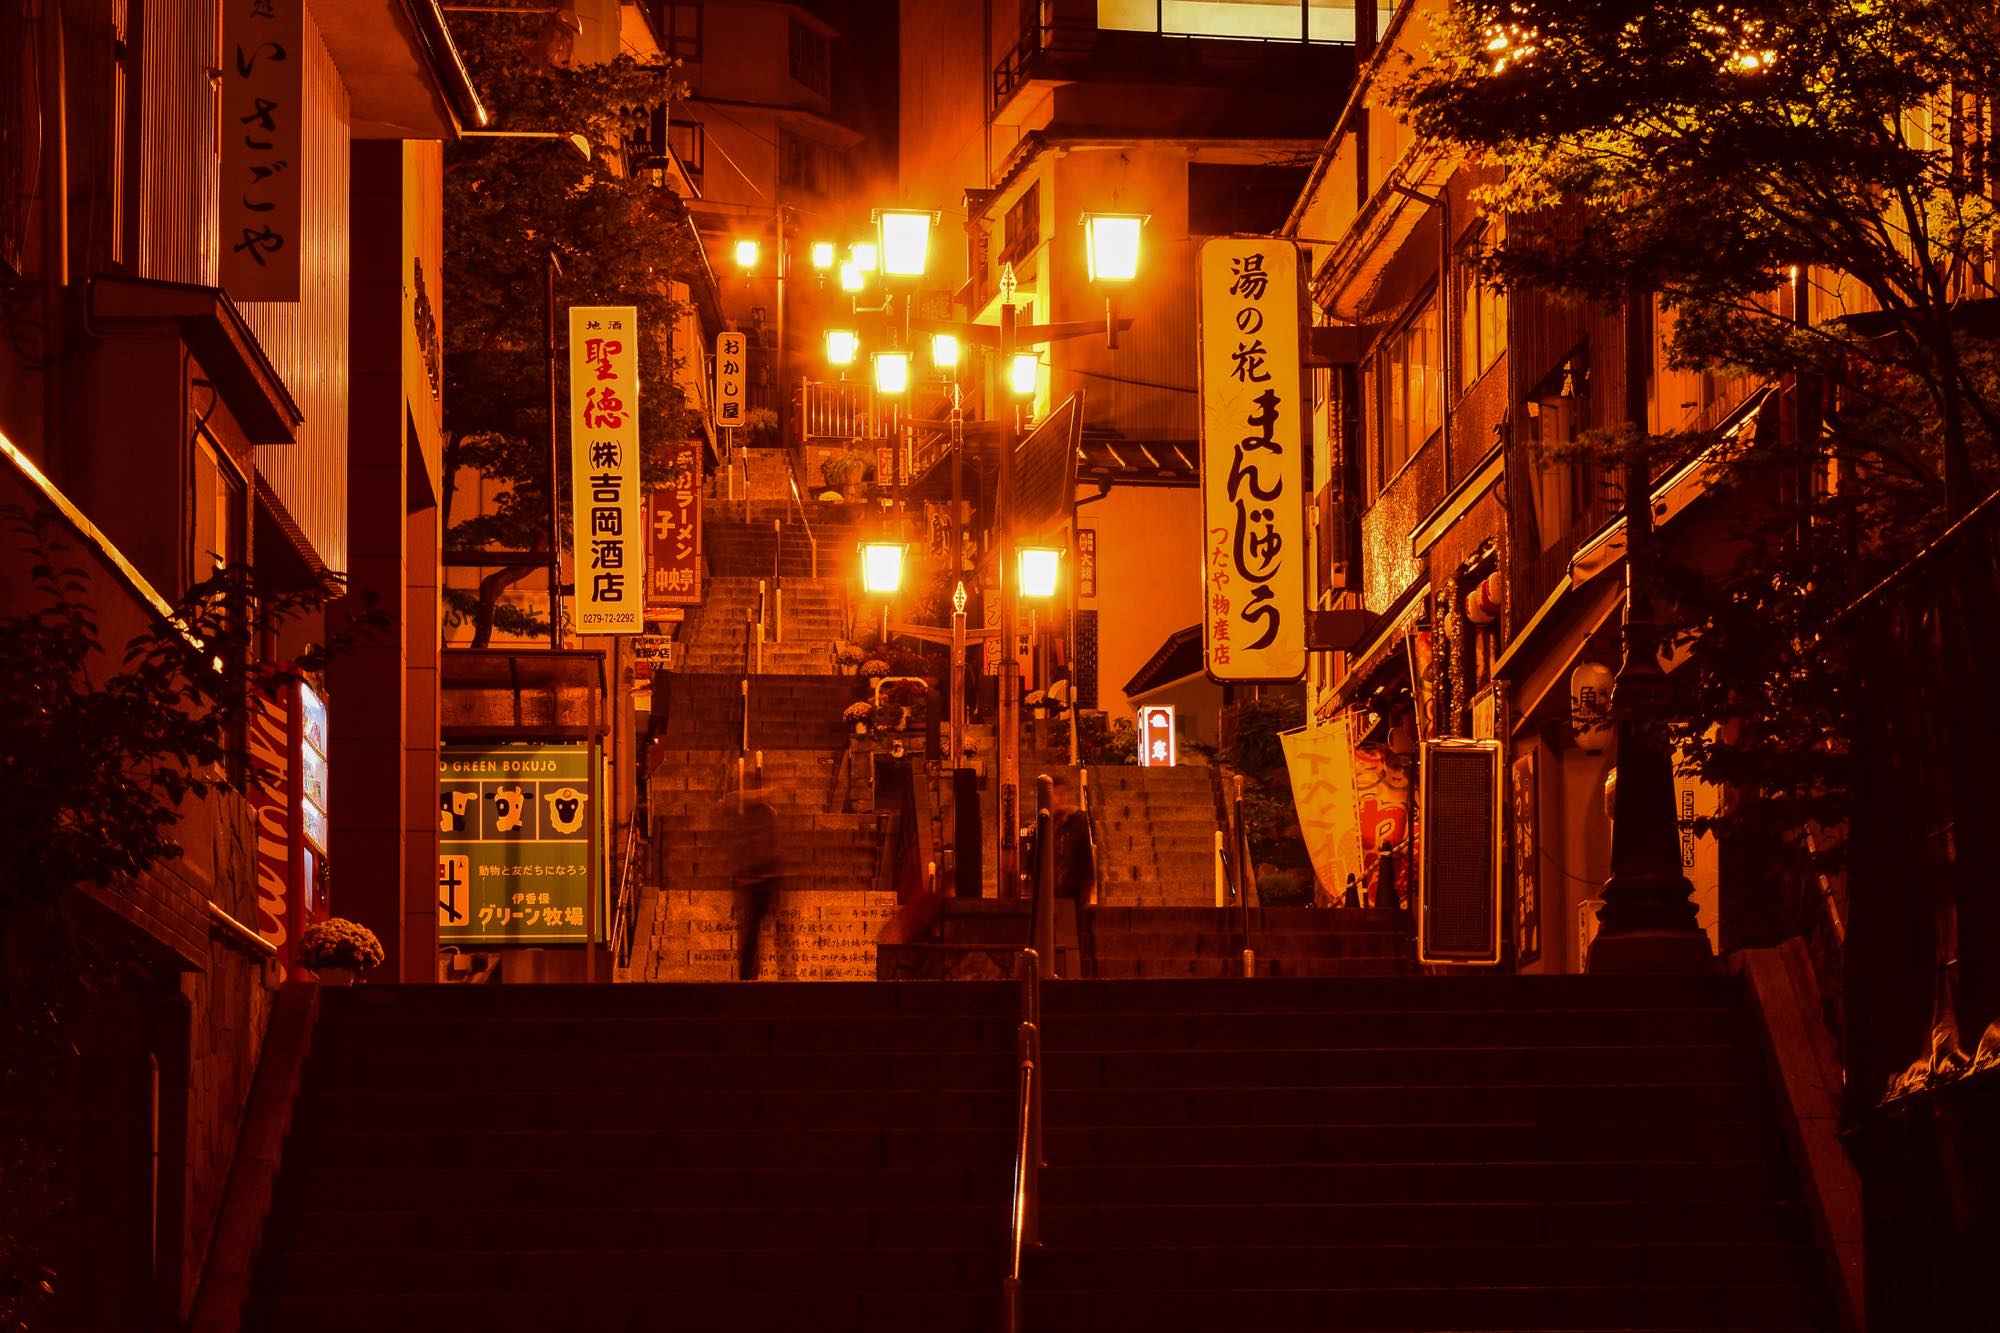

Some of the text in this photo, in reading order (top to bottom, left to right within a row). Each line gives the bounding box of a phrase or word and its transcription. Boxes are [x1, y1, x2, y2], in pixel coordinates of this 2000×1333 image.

[586, 320, 623, 331] 地酒
[584, 338, 630, 430] 聖徳
[722, 339, 741, 420] おかし屋
[1227, 253, 1284, 651] 湯の花まんじゅう
[1210, 527, 1231, 666] つたや物産店
[583, 613, 635, 624] 0279-72-2292
[453, 760, 497, 772] GREEN
[1682, 791, 1695, 829] TATION
[479, 865, 588, 877] 動物と友だちになろう
[512, 893, 551, 905] 伊香保
[479, 904, 584, 927] グリーン牧場
